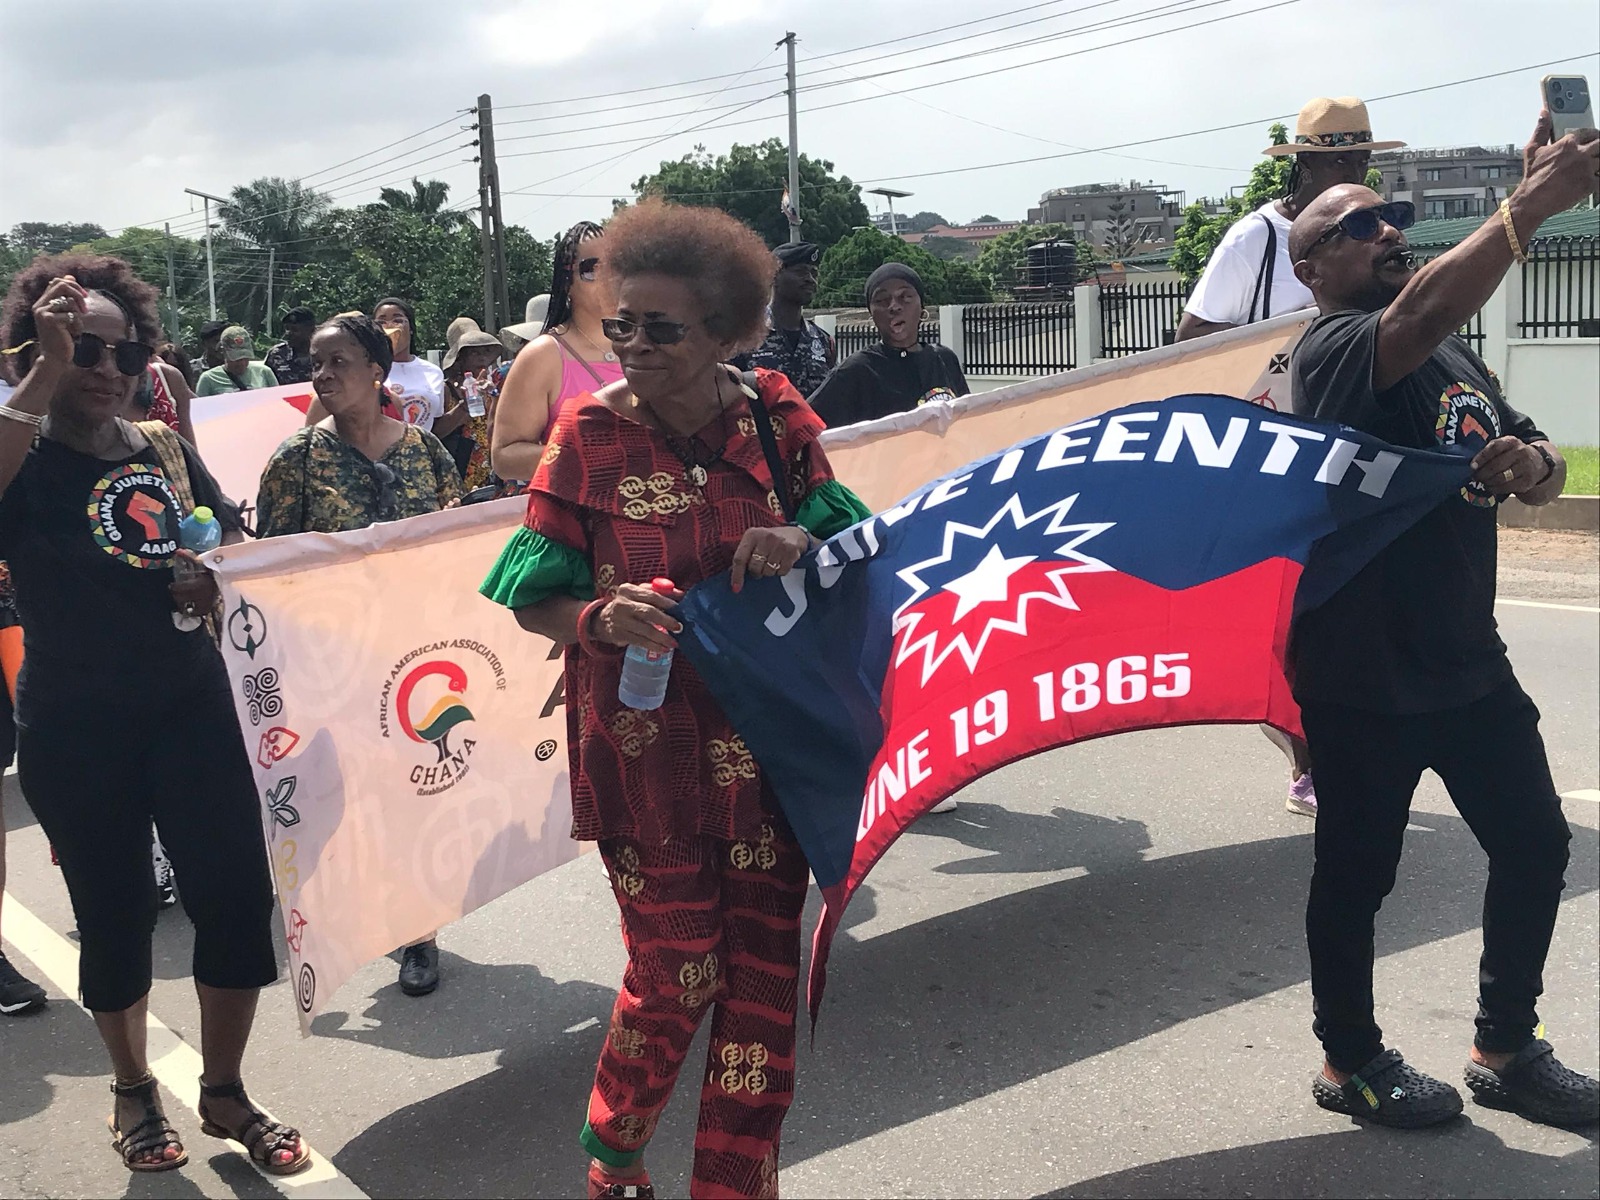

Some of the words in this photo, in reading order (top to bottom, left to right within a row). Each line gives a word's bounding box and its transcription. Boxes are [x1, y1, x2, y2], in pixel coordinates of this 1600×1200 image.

[1450, 394, 1500, 438] JUNETEEN
[100, 493, 122, 542] GHANA
[140, 540, 177, 555] AAAG
[380, 679, 392, 738] AFRICAN
[391, 640, 449, 680] AMERICAN
[449, 638, 505, 678] ASSOCIATION
[496, 677, 507, 691] OF
[409, 737, 477, 785] GHANA
[855, 729, 933, 842] UNE
[950, 689, 1009, 757] 19
[1033, 652, 1191, 722] 1865
